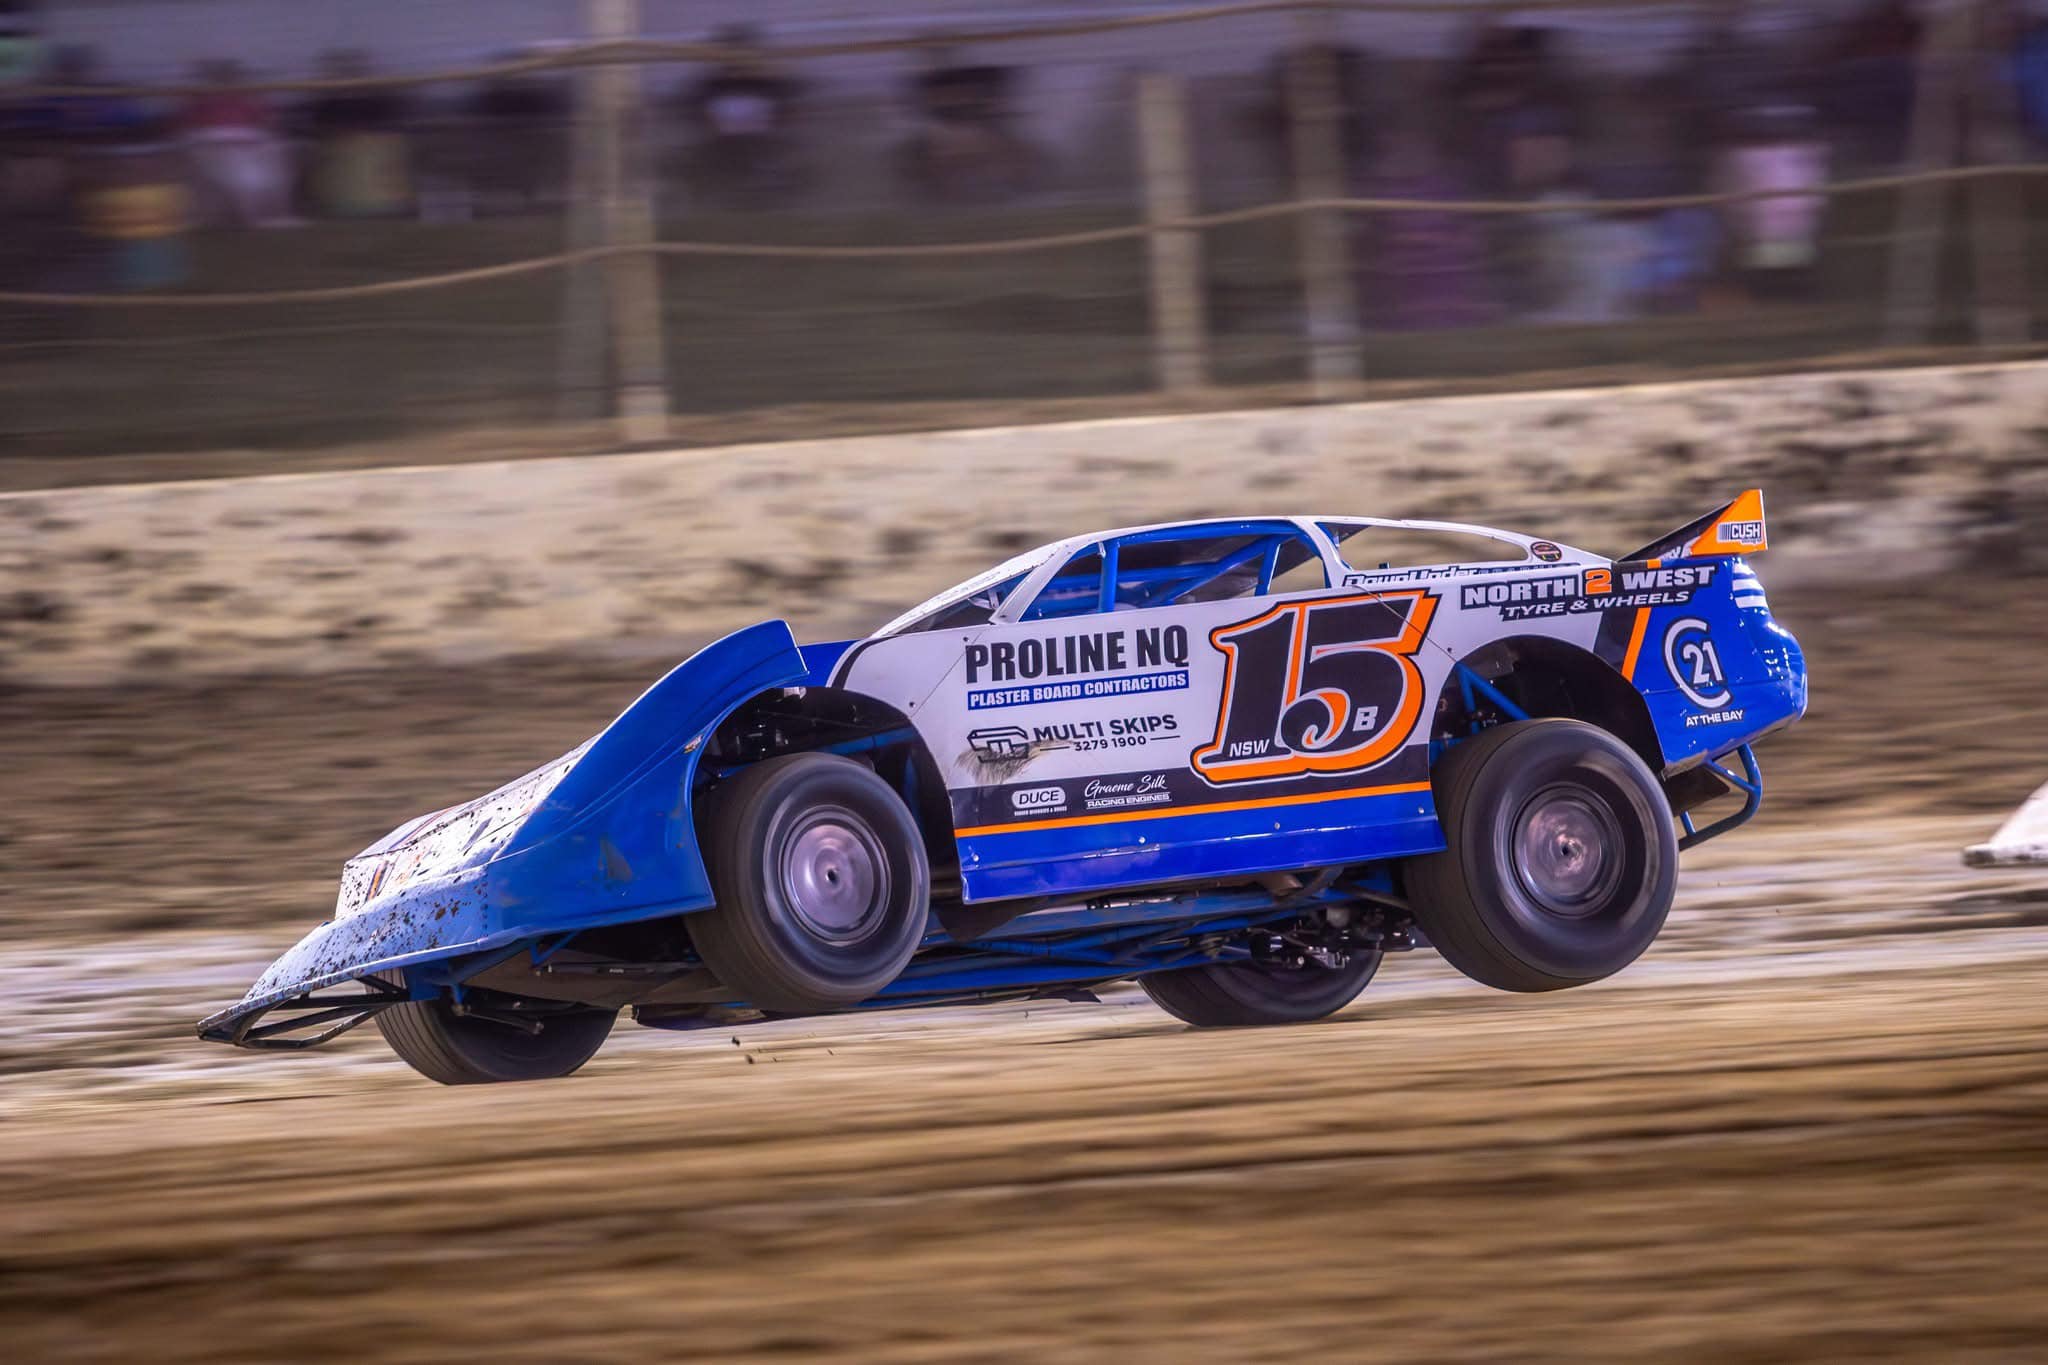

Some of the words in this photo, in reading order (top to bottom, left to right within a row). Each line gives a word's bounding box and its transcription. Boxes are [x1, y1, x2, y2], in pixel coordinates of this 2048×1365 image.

[1731, 523, 1761, 539] CUSH
[1463, 577, 1575, 606] NORTH
[1584, 569, 1612, 595] 2
[1621, 565, 1715, 591] WEST
[1506, 602, 1566, 618] TYRE
[1570, 597, 1589, 611] &
[1593, 590, 1689, 610] WHEELS
[965, 630, 1127, 685] PROLINE
[1135, 624, 1190, 668] NQ
[969, 690, 1030, 708] PLASTER
[1033, 683, 1081, 700] BOARD
[1084, 673, 1187, 695] CONTRACTORS
[1191, 588, 1440, 784] 15
[1033, 721, 1103, 742] MULTI
[1109, 714, 1178, 736] SKIPS
[1352, 705, 1379, 732] B
[1685, 715, 1699, 727] AT
[1700, 712, 1722, 725] THE
[1722, 709, 1744, 722] BAY
[1073, 740, 1109, 752] 3279
[1111, 735, 1147, 748] 1900
[1229, 738, 1270, 758] NSW
[1019, 789, 1060, 805] DUCE
[1084, 779, 1135, 799] Graeme
[1136, 774, 1168, 794] Silk
[1087, 799, 1125, 808] RACING
[1126, 793, 1170, 804] ENGINES
